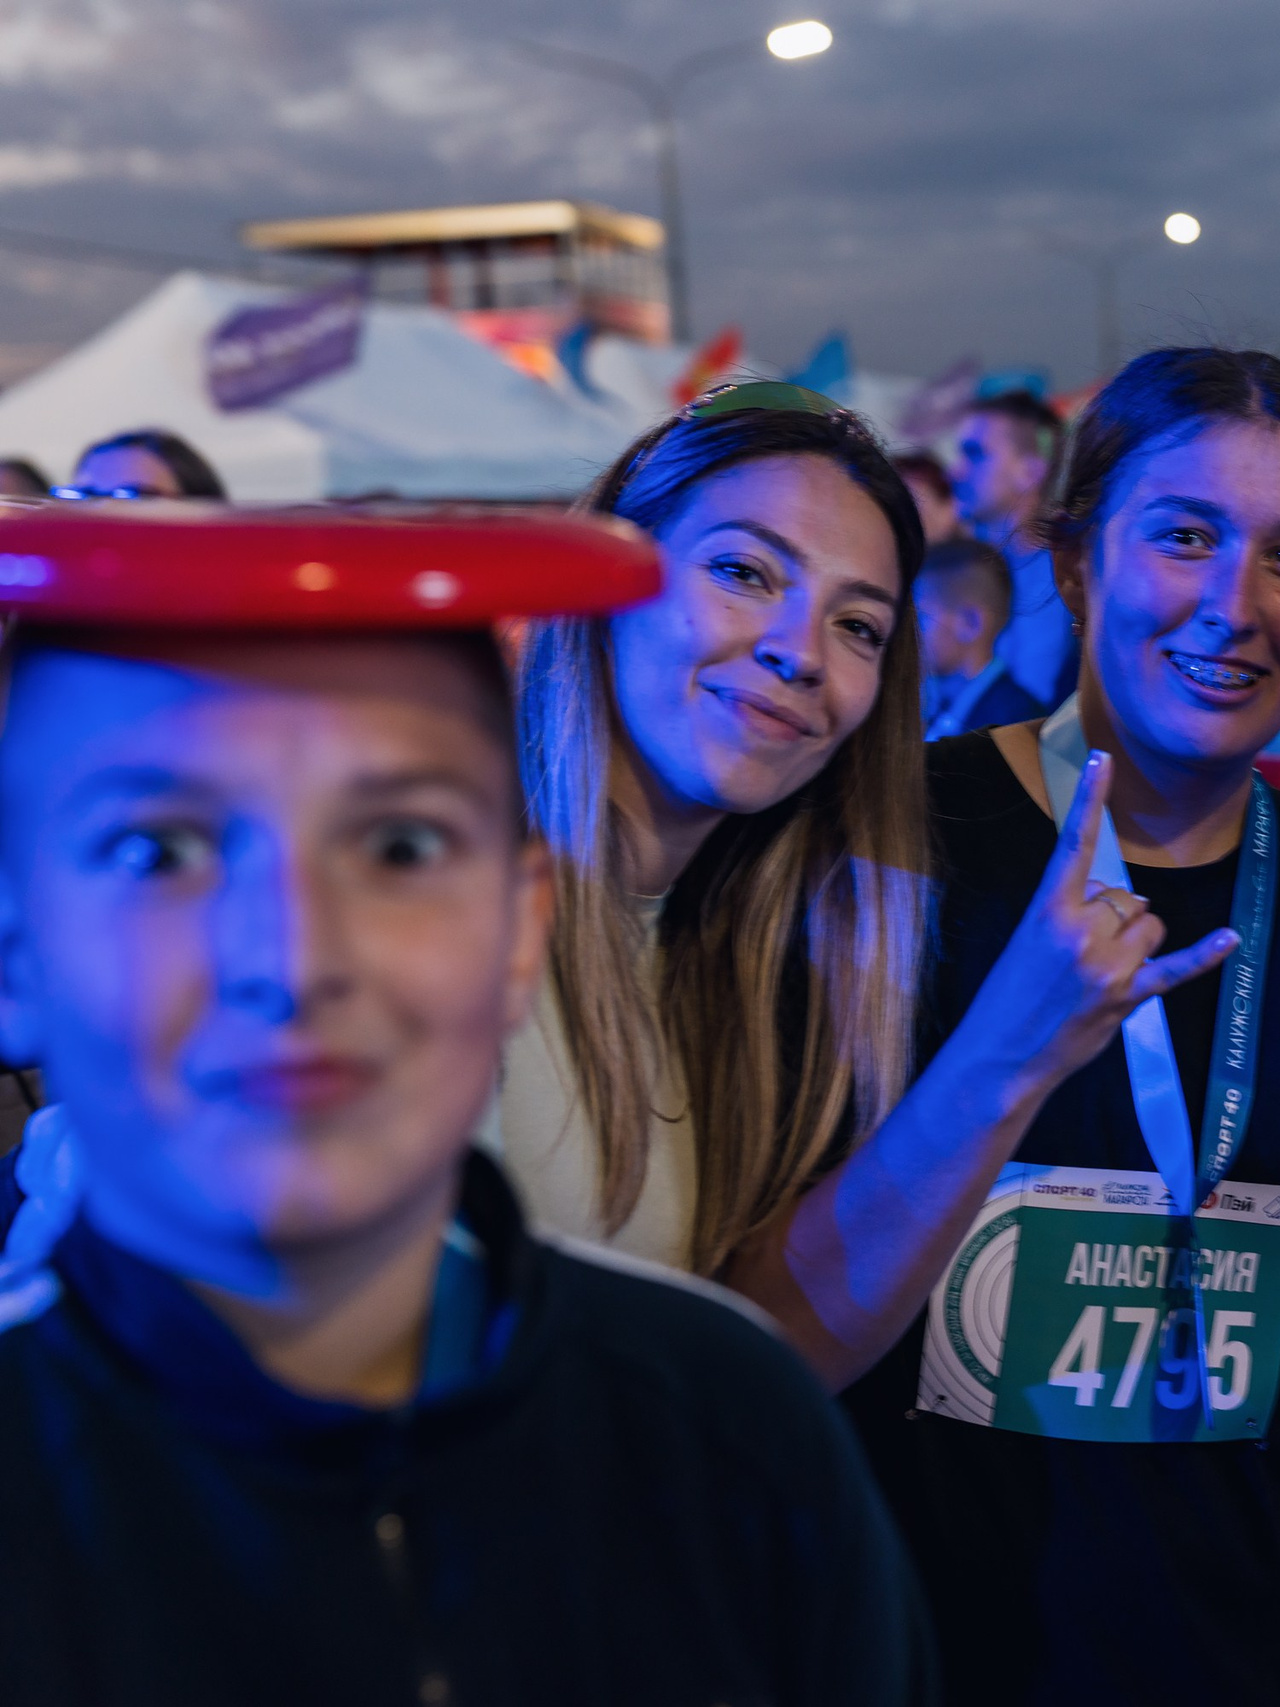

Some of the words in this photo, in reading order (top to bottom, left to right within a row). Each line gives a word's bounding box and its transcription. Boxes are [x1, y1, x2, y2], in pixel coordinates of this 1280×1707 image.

[1225, 963, 1257, 1070] КАЛУЖСКИЙ
[1223, 1087, 1243, 1116] 40
[1033, 1183, 1077, 1197] СПОРТ
[1079, 1186, 1098, 1198] 40
[1065, 1243, 1260, 1293] АНАСТАСИЯ
[1047, 1304, 1257, 1411] 4795
